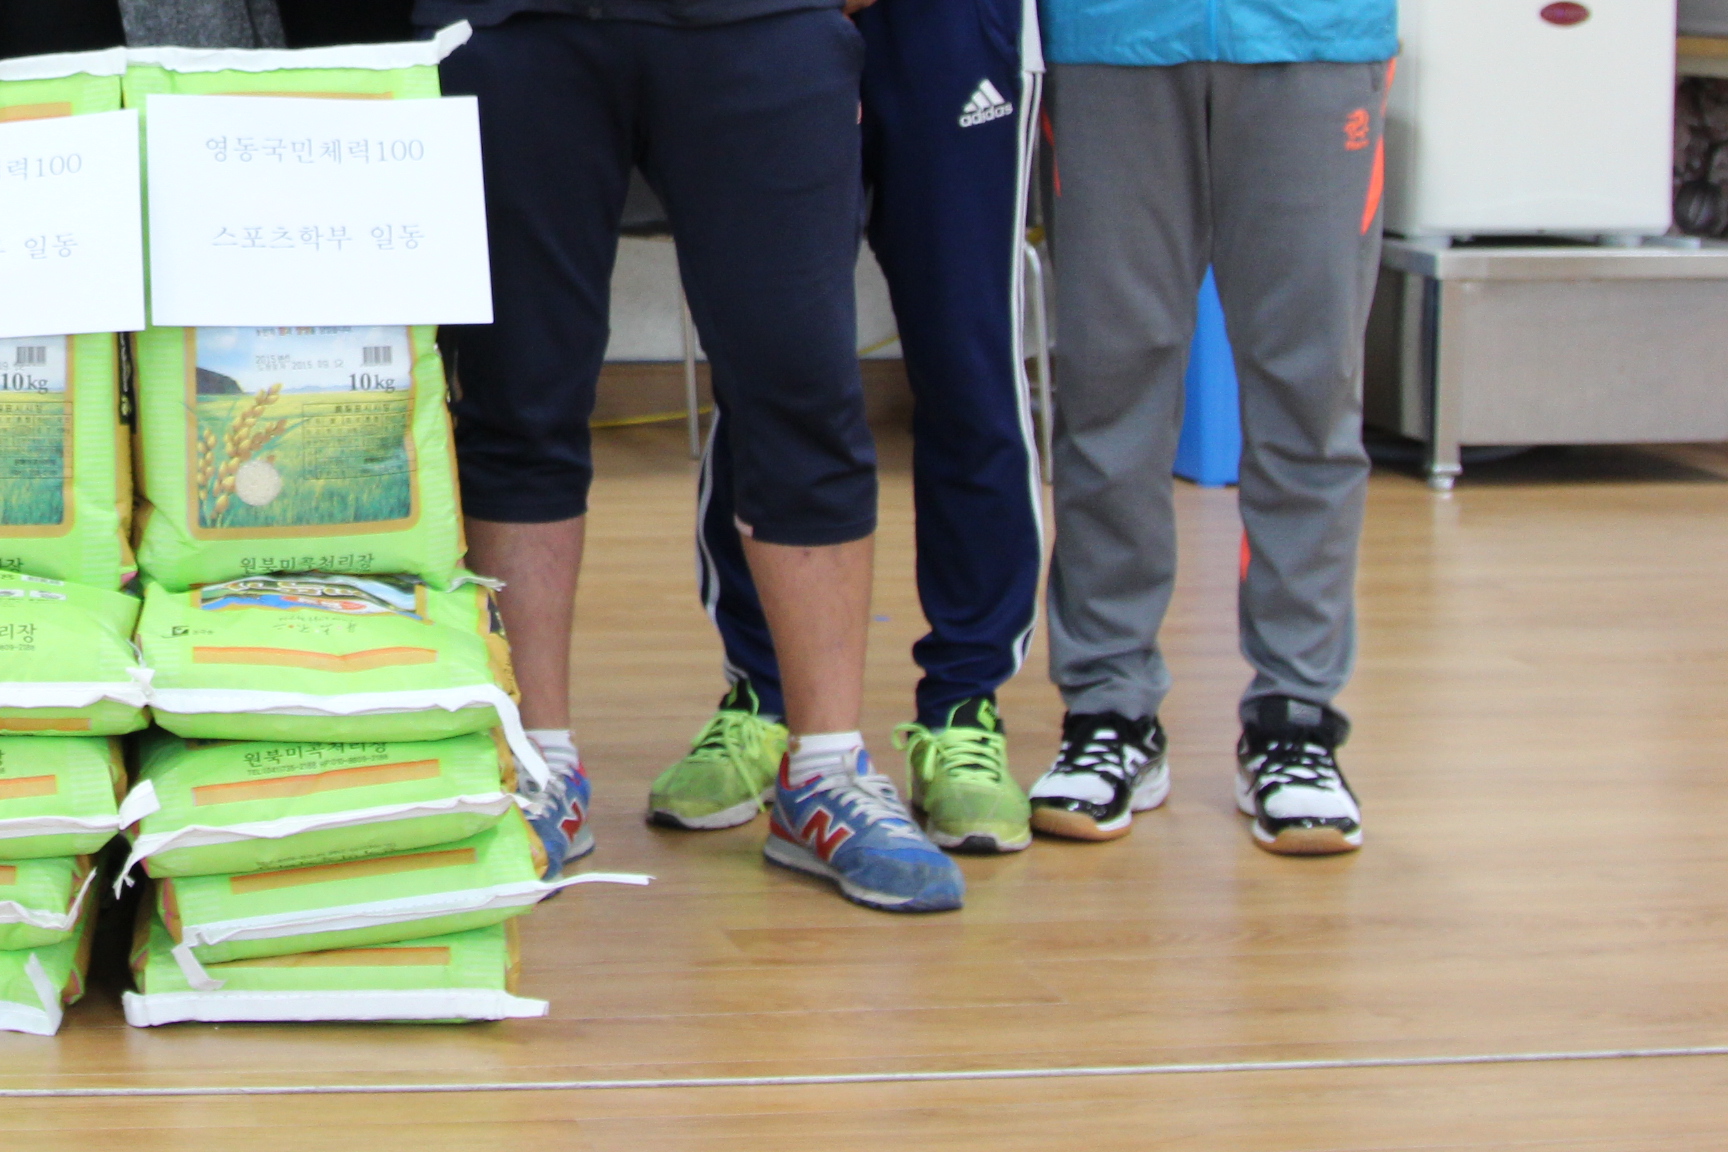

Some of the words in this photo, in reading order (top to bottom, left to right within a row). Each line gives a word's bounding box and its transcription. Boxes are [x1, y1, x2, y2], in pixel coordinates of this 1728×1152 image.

[958, 101, 1014, 128] adidas
[205, 135, 425, 165] 영동국민체력100
[23, 232, 79, 261] 일동
[211, 225, 353, 252] 스포츠학부
[370, 224, 425, 251] 일동
[240, 553, 375, 575] 원북미곡처리장
[799, 804, 857, 863] N
